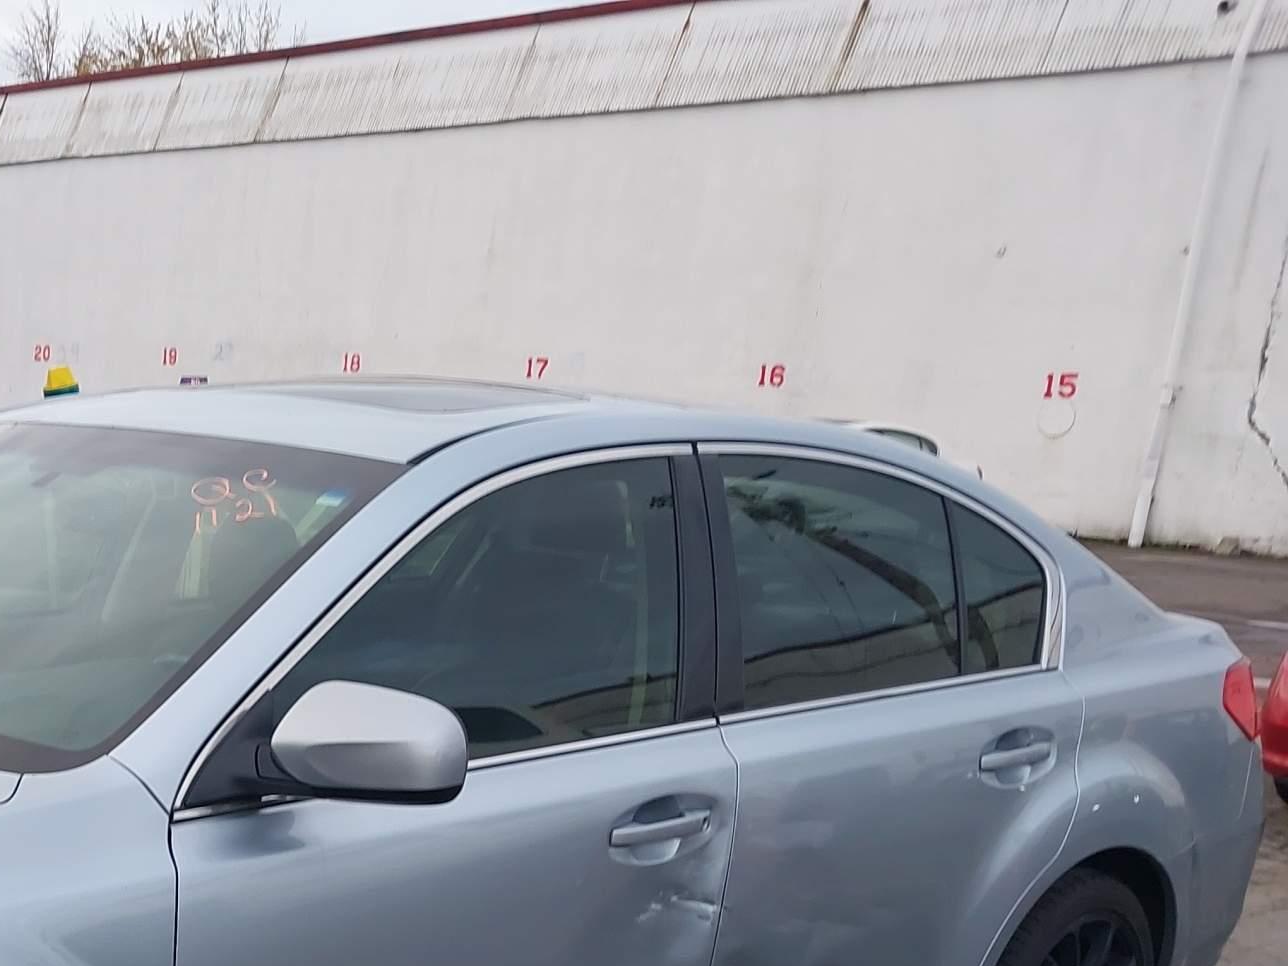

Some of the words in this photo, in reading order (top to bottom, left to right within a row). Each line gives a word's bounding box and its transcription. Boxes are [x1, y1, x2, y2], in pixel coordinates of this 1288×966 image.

[34, 344, 51, 362] 20
[343, 352, 361, 373] 18
[526, 357, 550, 380] 17
[758, 364, 785, 388] 16
[1043, 372, 1079, 399] 15
